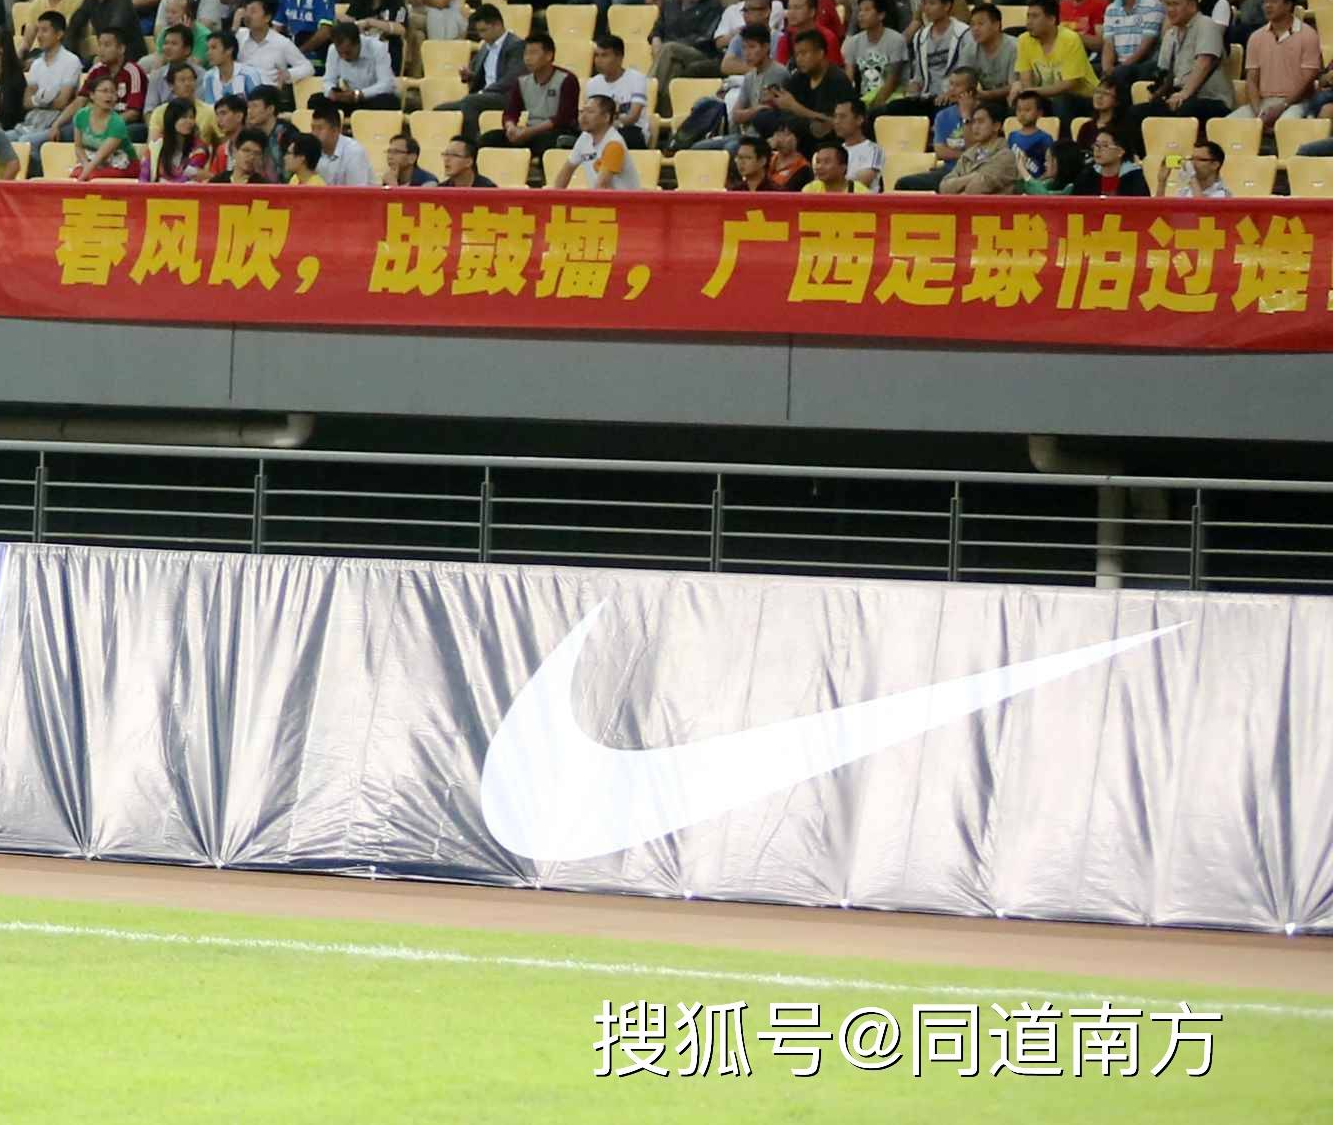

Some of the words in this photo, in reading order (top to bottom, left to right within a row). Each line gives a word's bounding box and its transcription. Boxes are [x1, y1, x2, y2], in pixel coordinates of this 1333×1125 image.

[54, 194, 1333, 315] 春风吹，战鼓擂，广西足球怕过谁
